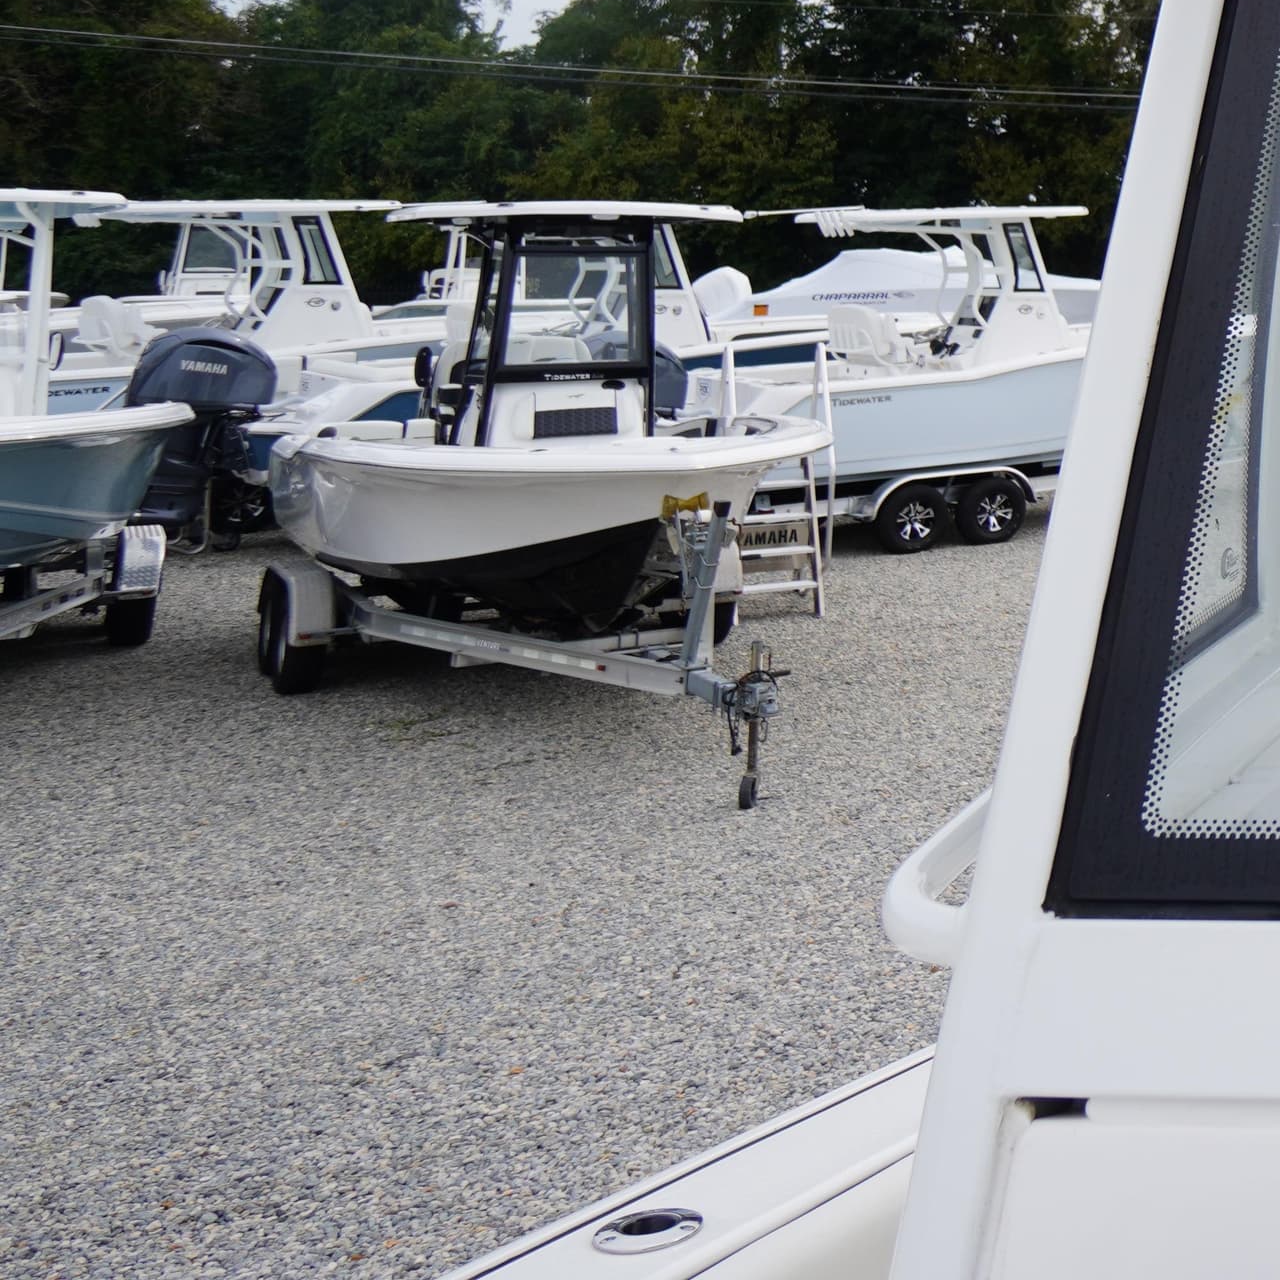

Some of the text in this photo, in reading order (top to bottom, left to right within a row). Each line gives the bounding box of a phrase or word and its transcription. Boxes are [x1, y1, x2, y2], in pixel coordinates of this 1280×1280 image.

[812, 291, 892, 301] CHAPARRAL
[180, 359, 229, 376] YAMAHA
[544, 372, 591, 381] TIDEWATER
[48, 385, 111, 398] DEWATER
[831, 394, 893, 408] TIDEWATER
